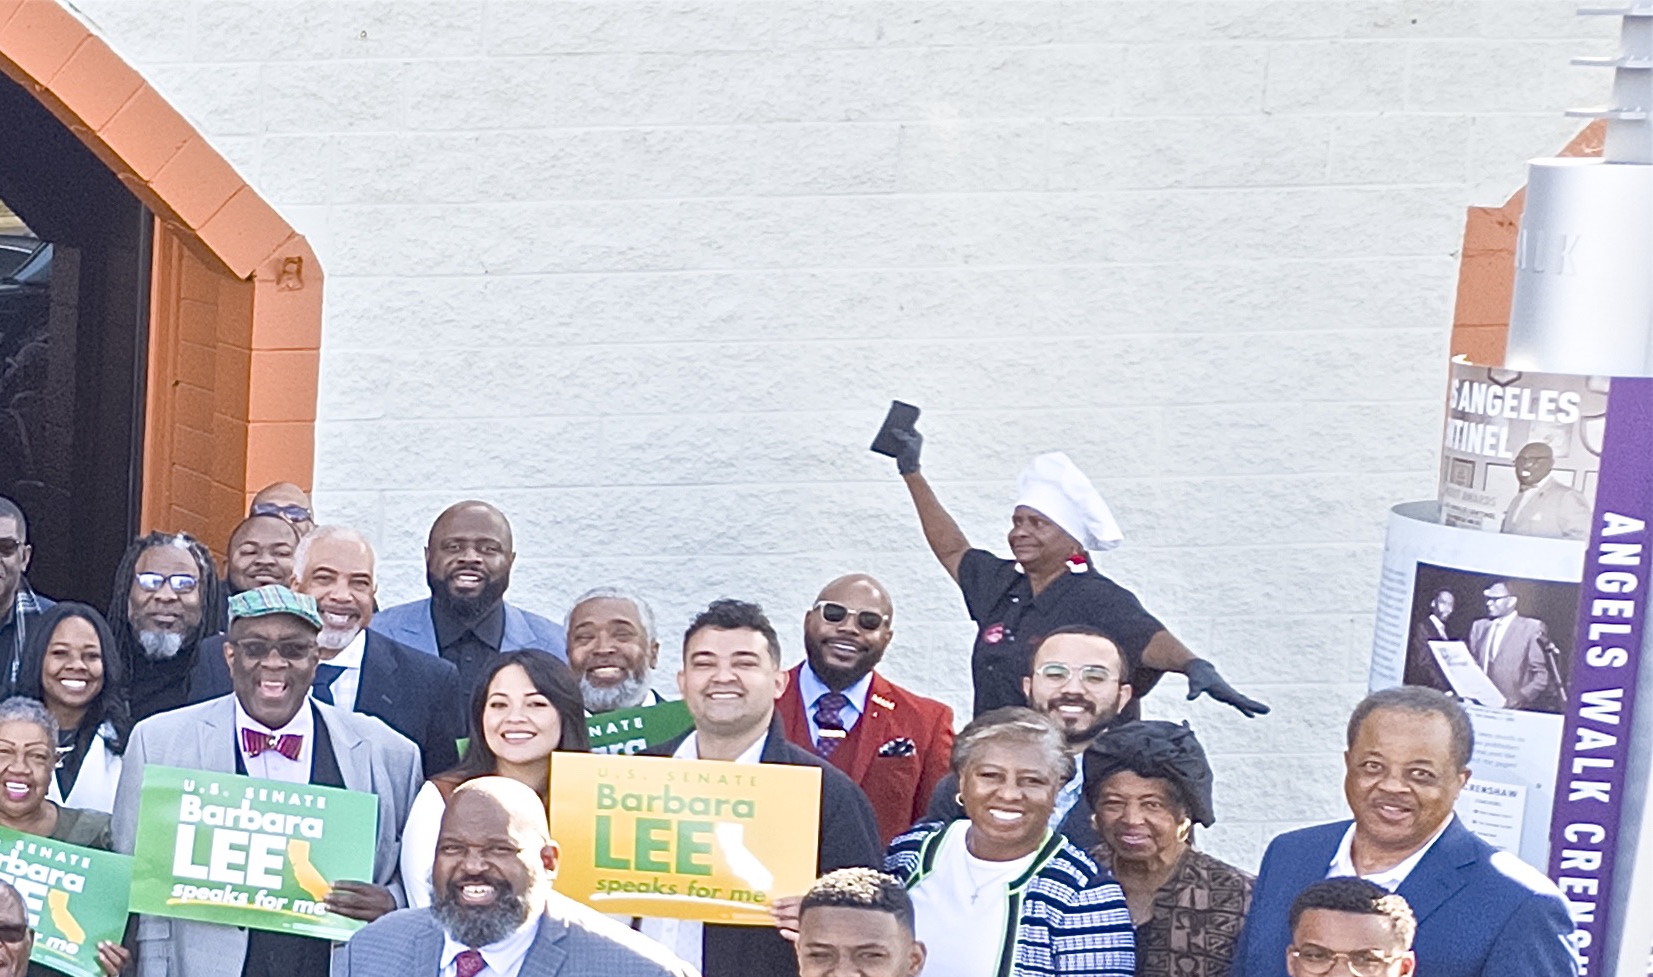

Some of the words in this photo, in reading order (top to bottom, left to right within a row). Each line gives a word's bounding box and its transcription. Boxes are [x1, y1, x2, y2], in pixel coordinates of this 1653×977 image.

[1458, 381, 1581, 424] ANGELES
[1586, 512, 1645, 667] ANGELS
[589, 717, 643, 737] NATE
[1567, 688, 1624, 803] WALK
[184, 779, 229, 797] U.S.
[245, 787, 326, 809] SENATE
[597, 768, 646, 781] U.S.
[667, 770, 758, 787] SENATE
[180, 795, 323, 839] Barbara
[597, 783, 755, 818] Barbara
[15, 840, 91, 869] SENATE
[173, 824, 287, 889] LEE
[595, 815, 714, 876] LEE
[171, 883, 248, 904] speaks
[255, 890, 288, 909] for
[292, 902, 329, 915] me
[596, 877, 678, 895] speaks
[688, 880, 722, 900] for
[730, 888, 766, 903] me
[46, 935, 79, 953] me
